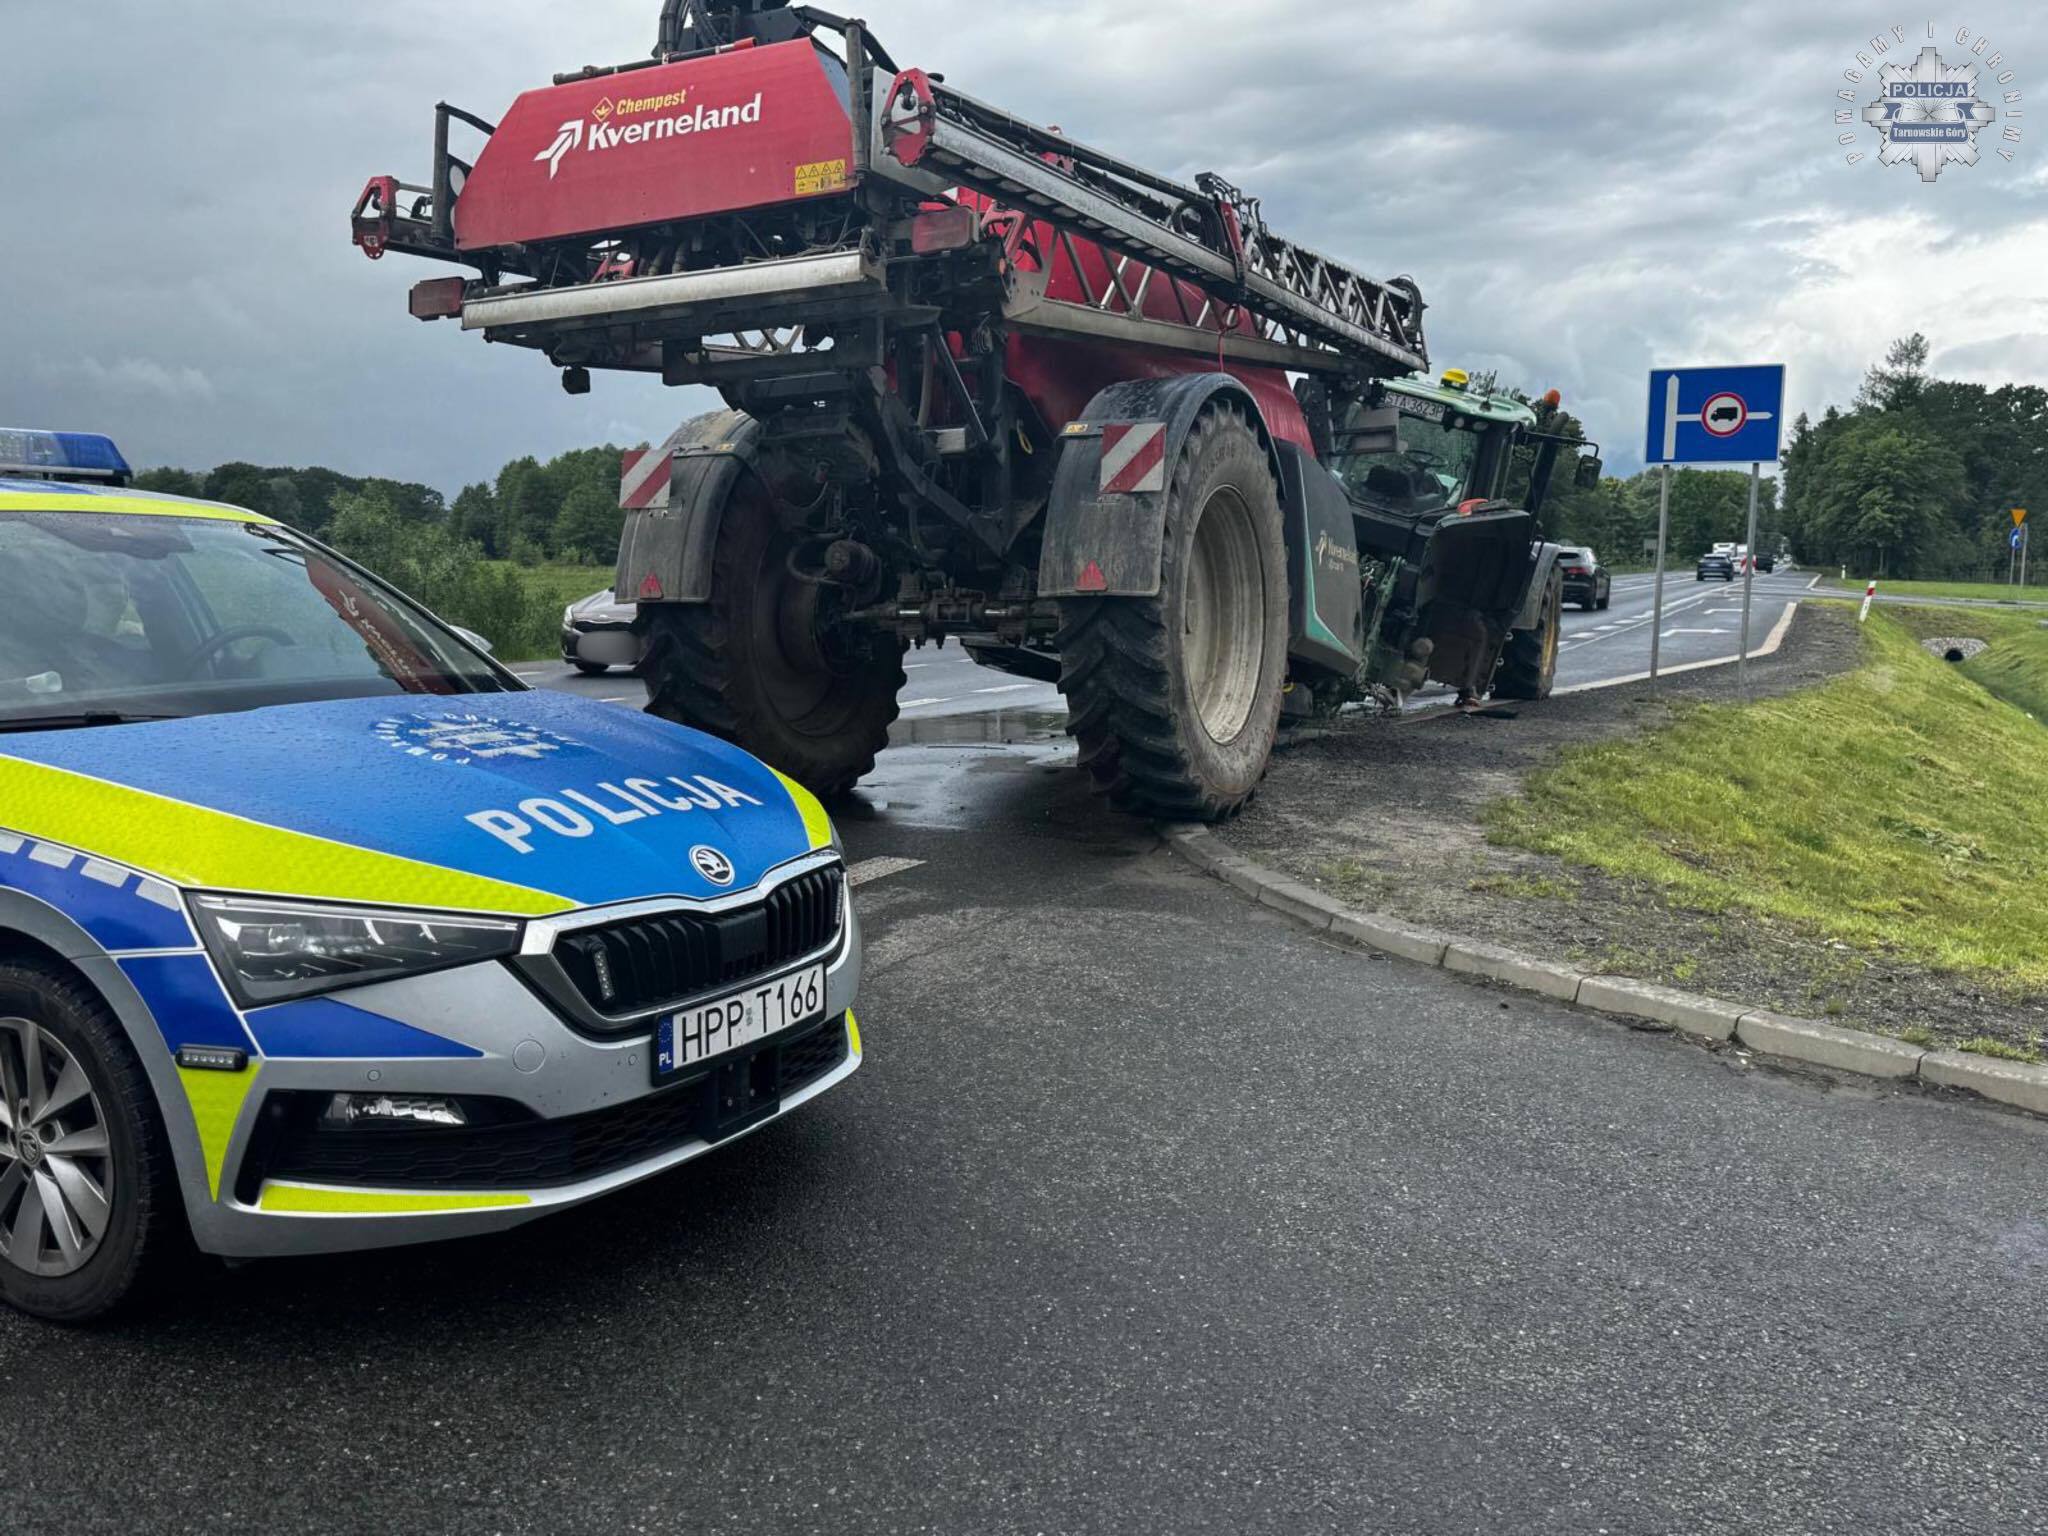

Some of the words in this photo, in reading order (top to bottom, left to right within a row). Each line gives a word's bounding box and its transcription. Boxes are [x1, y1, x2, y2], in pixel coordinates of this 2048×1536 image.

[587, 92, 762, 151] Kverneland
[616, 89, 687, 116] Chempest
[464, 775, 765, 854] POLICJA
[681, 1000, 744, 1063] HPP
[756, 970, 818, 1034] T166
[658, 1054, 672, 1067] PL
